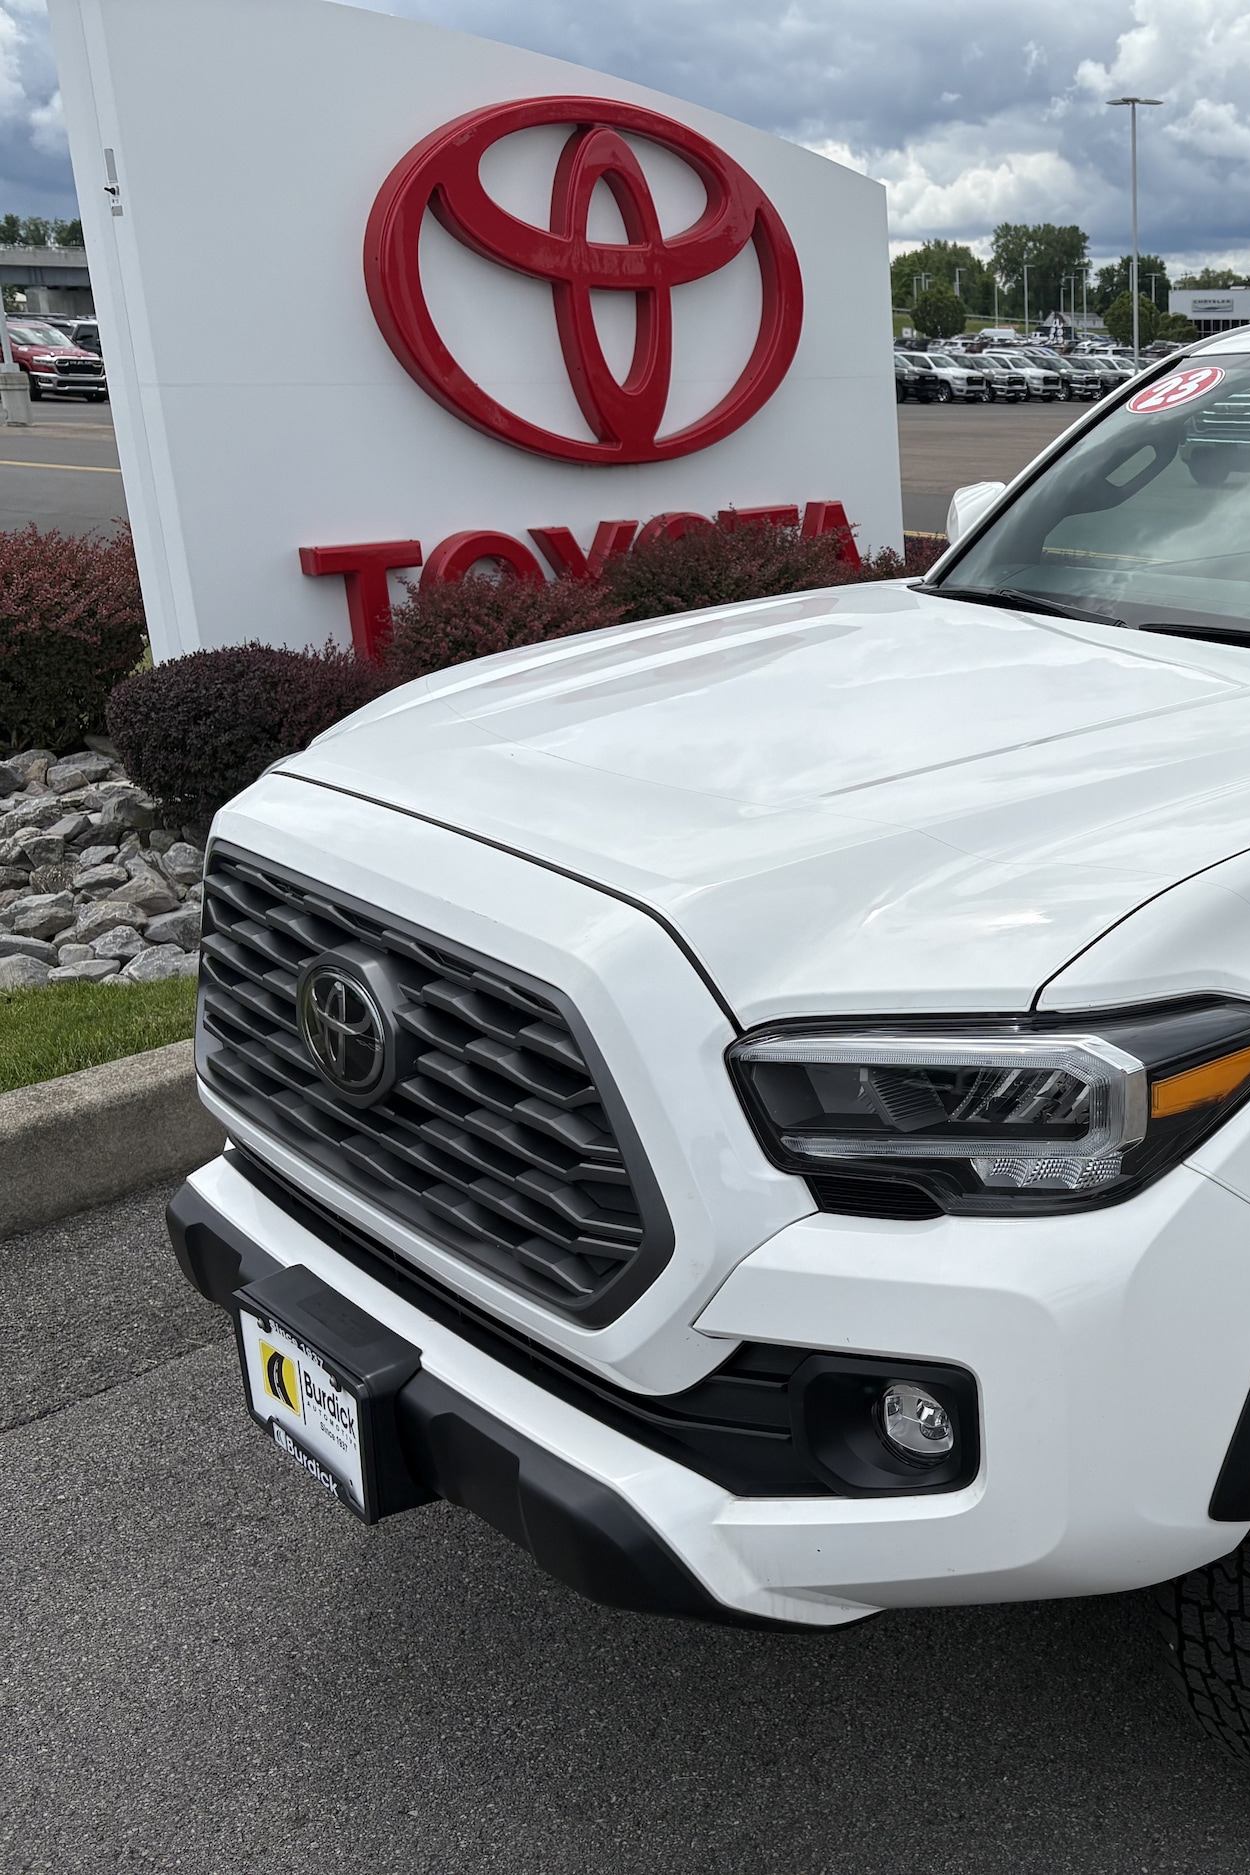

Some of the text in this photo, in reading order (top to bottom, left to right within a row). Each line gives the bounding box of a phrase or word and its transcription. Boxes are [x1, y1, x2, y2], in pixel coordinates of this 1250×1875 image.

[1136, 369, 1213, 411] 23
[303, 1370, 357, 1440] Burdick
[307, 1400, 357, 1451] AUTOMOTIVE
[286, 1435, 340, 1498] Burdick
